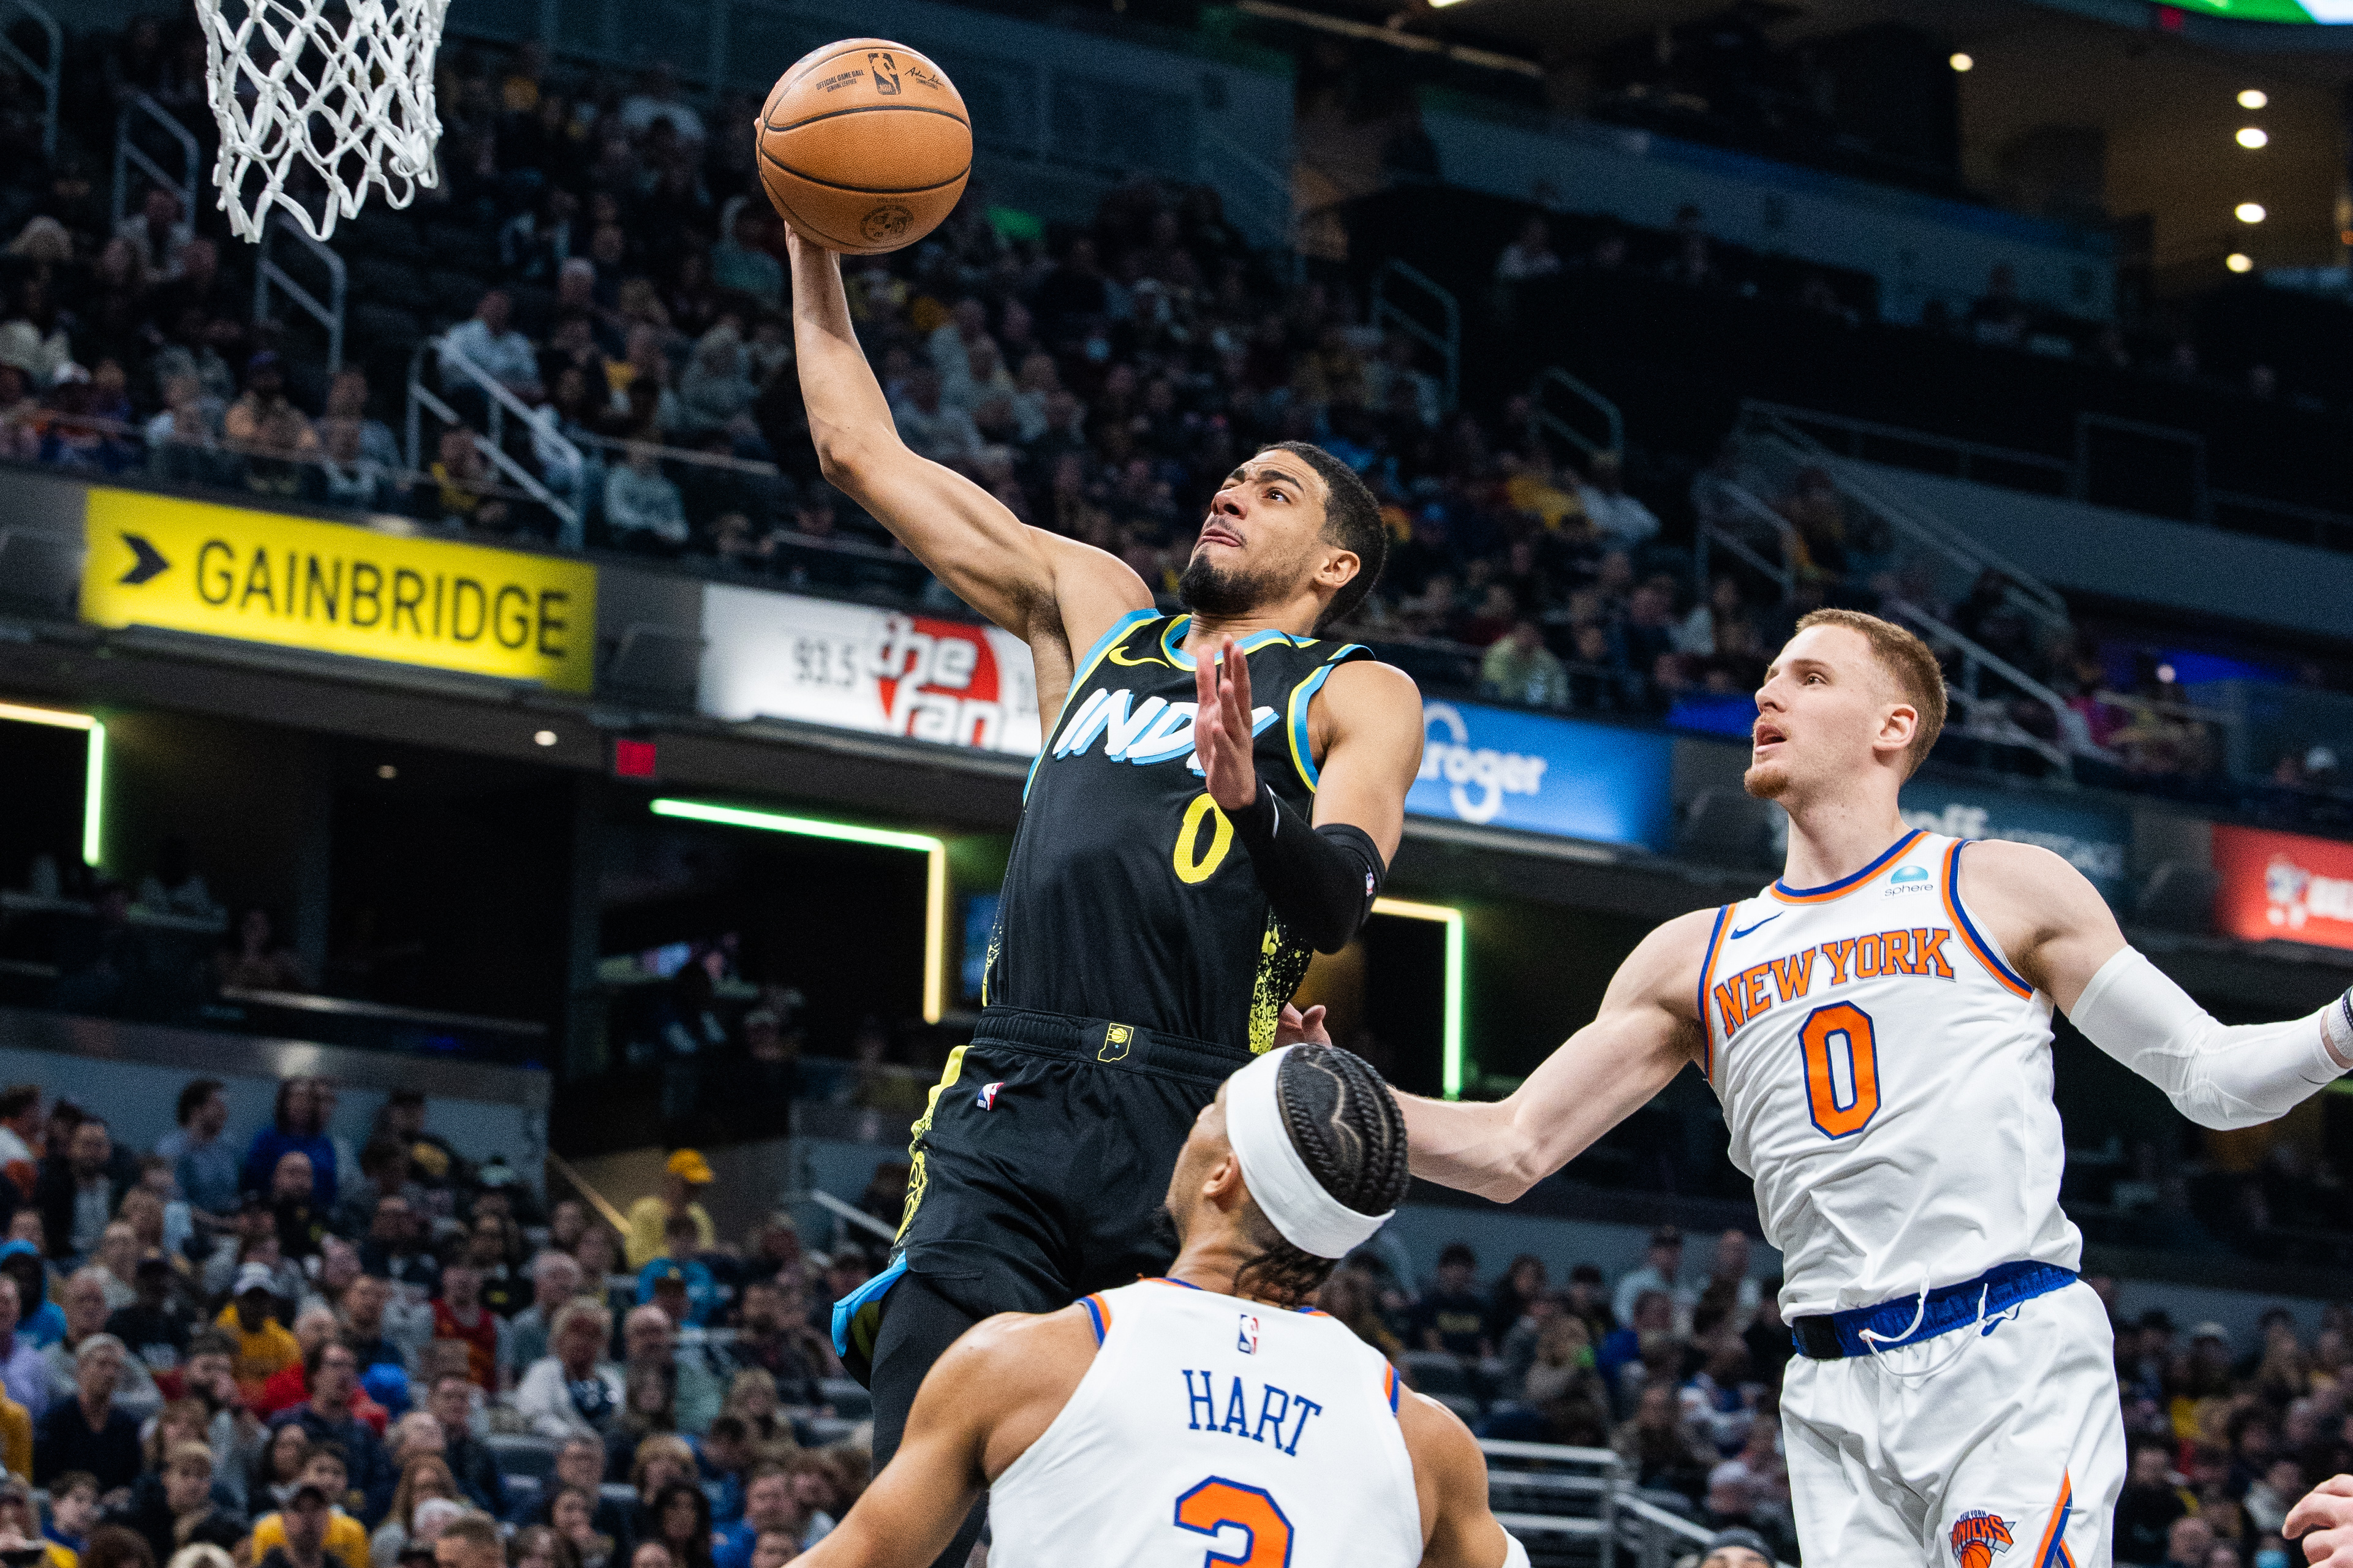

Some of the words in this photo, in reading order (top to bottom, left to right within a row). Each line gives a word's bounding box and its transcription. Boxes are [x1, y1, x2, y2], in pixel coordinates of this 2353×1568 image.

[816, 76, 837, 90] OFFICIAL
[837, 72, 852, 81] GAME
[852, 69, 864, 78] BALL
[195, 538, 570, 658] GAINBRIDGE
[870, 614, 979, 690] the
[1173, 793, 1234, 884] 0
[1884, 884, 1933, 897] sphere
[1714, 946, 1816, 1039] NEW
[1821, 927, 1957, 986] YORK
[976, 1099, 986, 1109] NBA
[1798, 1000, 1881, 1140] 0
[1181, 1370, 1323, 1457] HART
[1952, 1514, 2014, 1552] KNICKS
[1970, 1509, 1987, 1518] YORK
